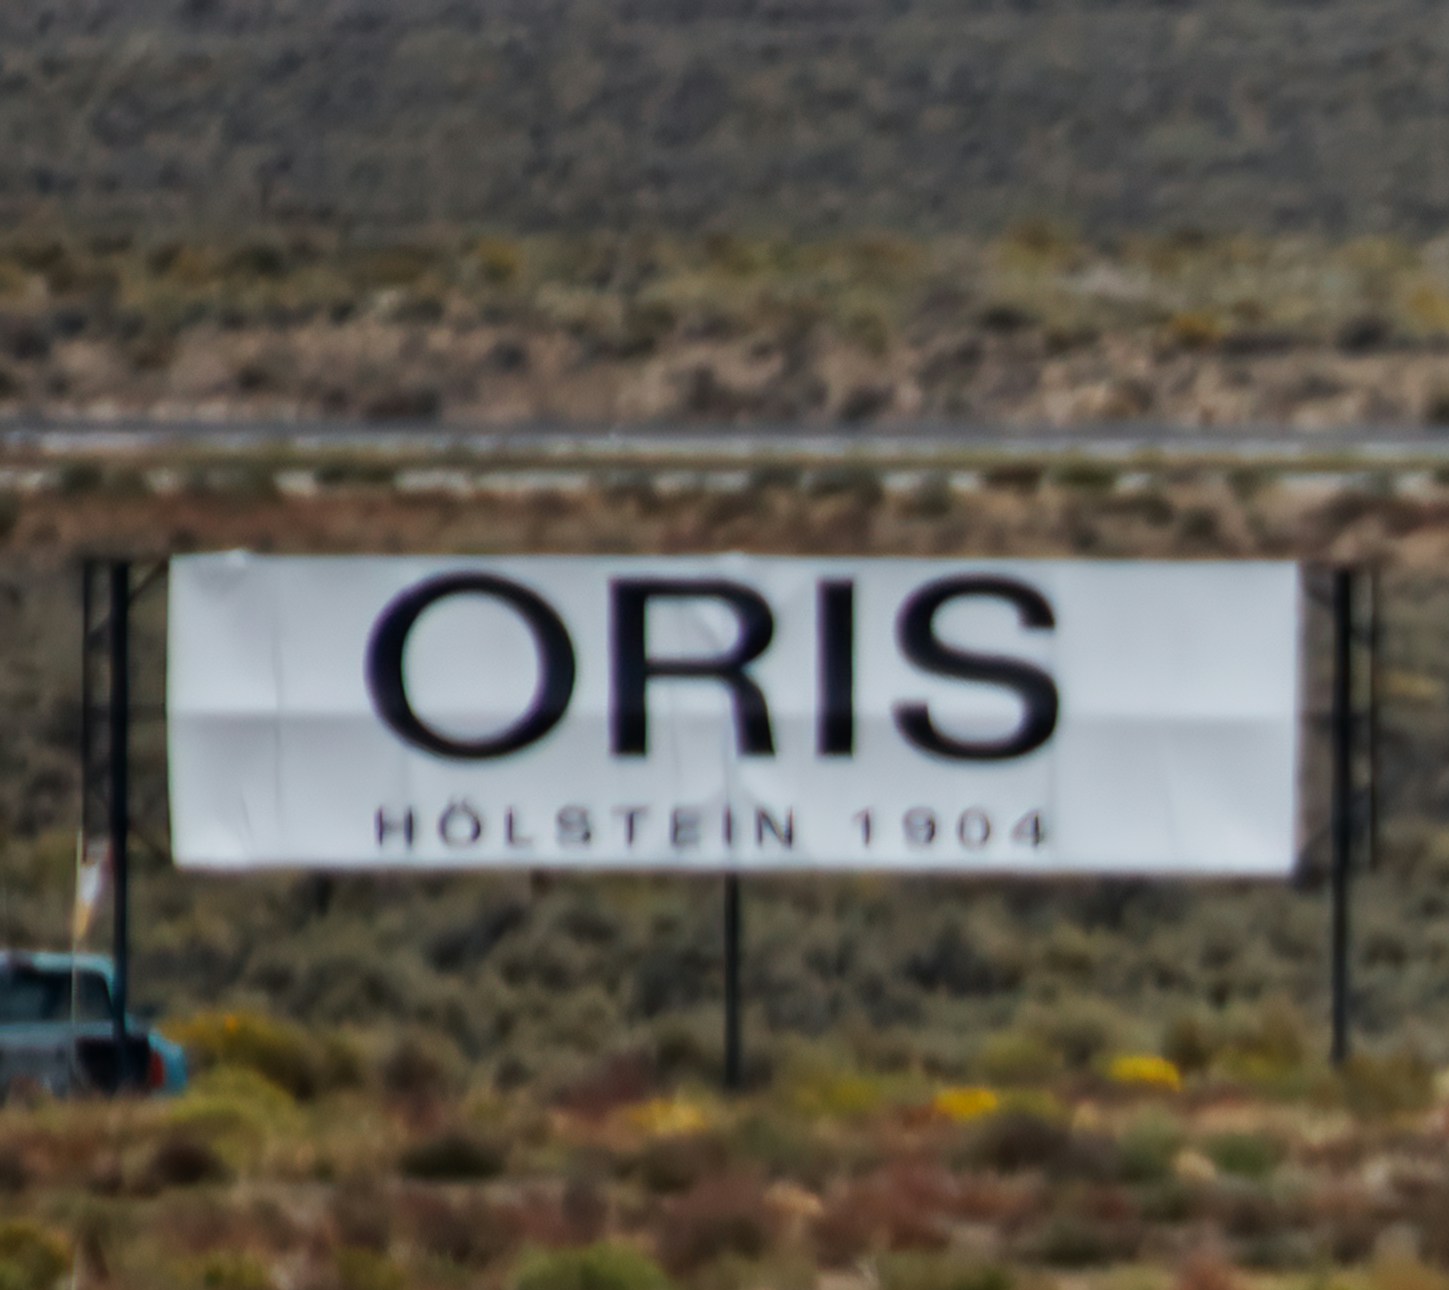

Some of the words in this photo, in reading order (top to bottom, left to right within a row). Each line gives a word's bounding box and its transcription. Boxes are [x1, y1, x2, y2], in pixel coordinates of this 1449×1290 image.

[365, 571, 1061, 762] ORIS
[375, 799, 796, 850] HÖLSTEIN
[853, 808, 1051, 850] 1904
